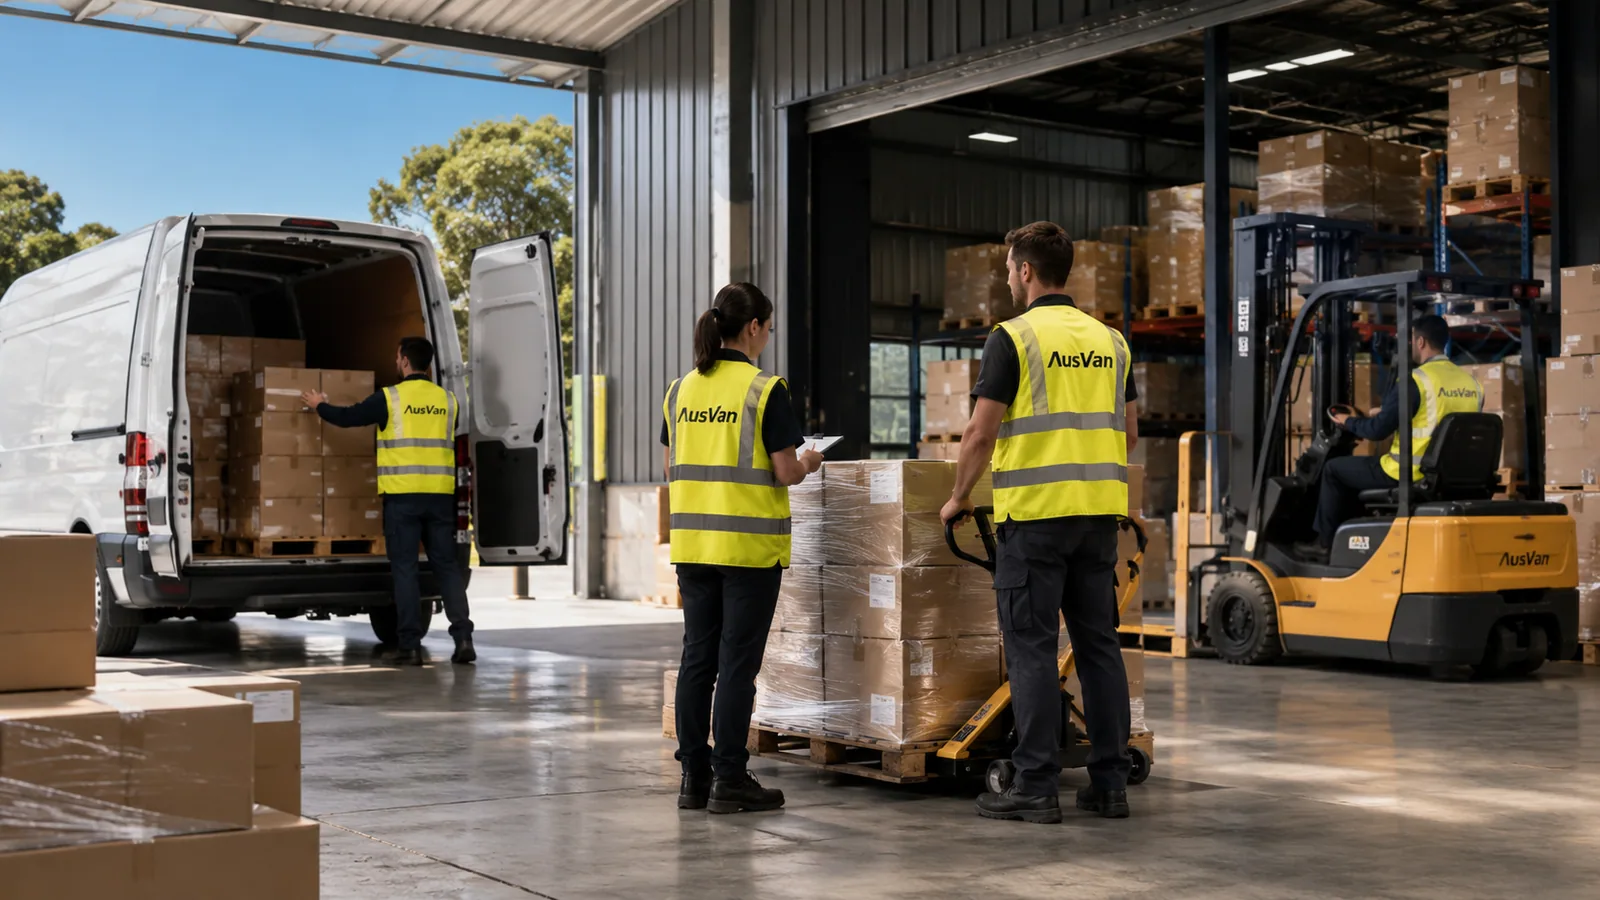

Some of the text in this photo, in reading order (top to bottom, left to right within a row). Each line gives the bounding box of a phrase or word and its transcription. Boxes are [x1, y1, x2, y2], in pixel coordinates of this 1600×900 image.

[1047, 350, 1113, 369] AusVan
[1437, 387, 1477, 398] AusVan
[404, 404, 447, 415] AusVan
[677, 405, 738, 424] AusVan
[1499, 550, 1550, 567] AusVan
